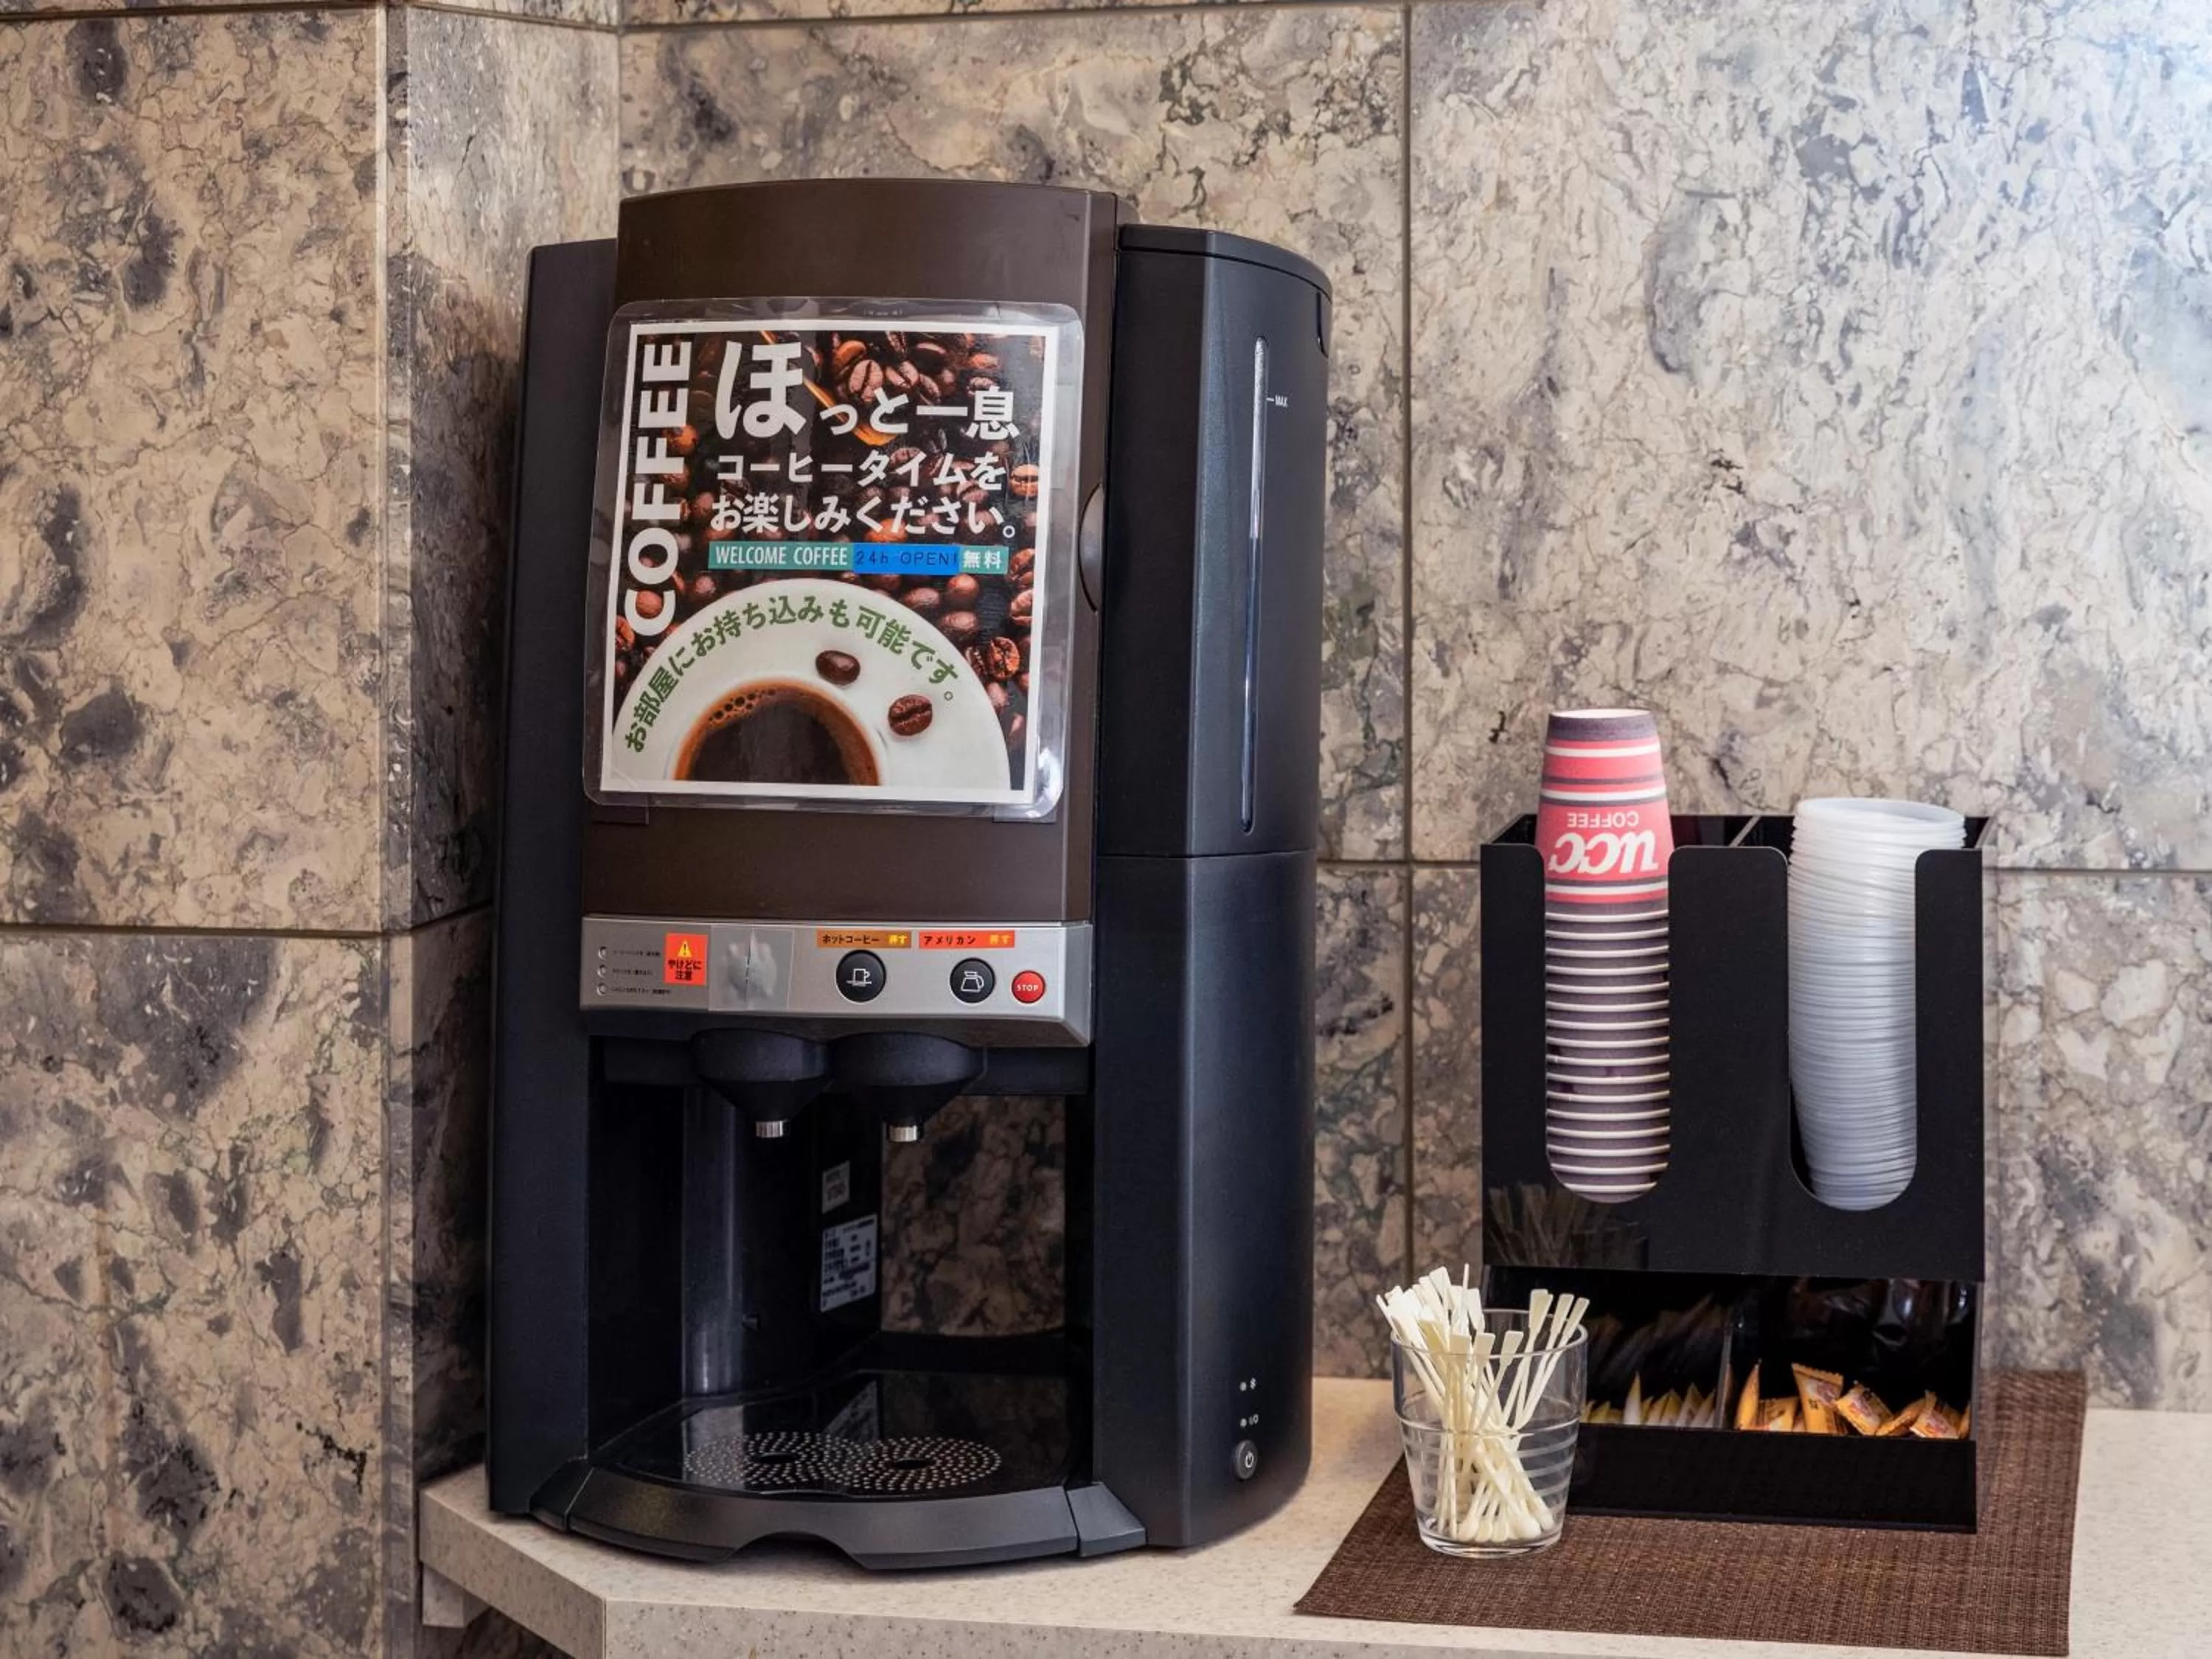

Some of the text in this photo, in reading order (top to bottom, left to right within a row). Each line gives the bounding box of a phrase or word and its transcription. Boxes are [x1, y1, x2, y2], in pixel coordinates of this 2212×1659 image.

[714, 341, 1020, 441] ほっと一息
[717, 452, 1008, 491] コーヒータイムを
[625, 340, 692, 637] COFFEE
[711, 493, 1017, 540] お楽しみください。
[715, 545, 787, 566] WELCOME
[793, 546, 848, 567] COFFEE
[962, 549, 1003, 570] 無料
[625, 594, 960, 754] お部屋にお持ち込みも可能です。
[1566, 810, 1640, 829] COFFEE
[822, 933, 880, 945] ホットコーヒー
[924, 935, 976, 946] アメリカン
[1016, 984, 1040, 992] STOP
